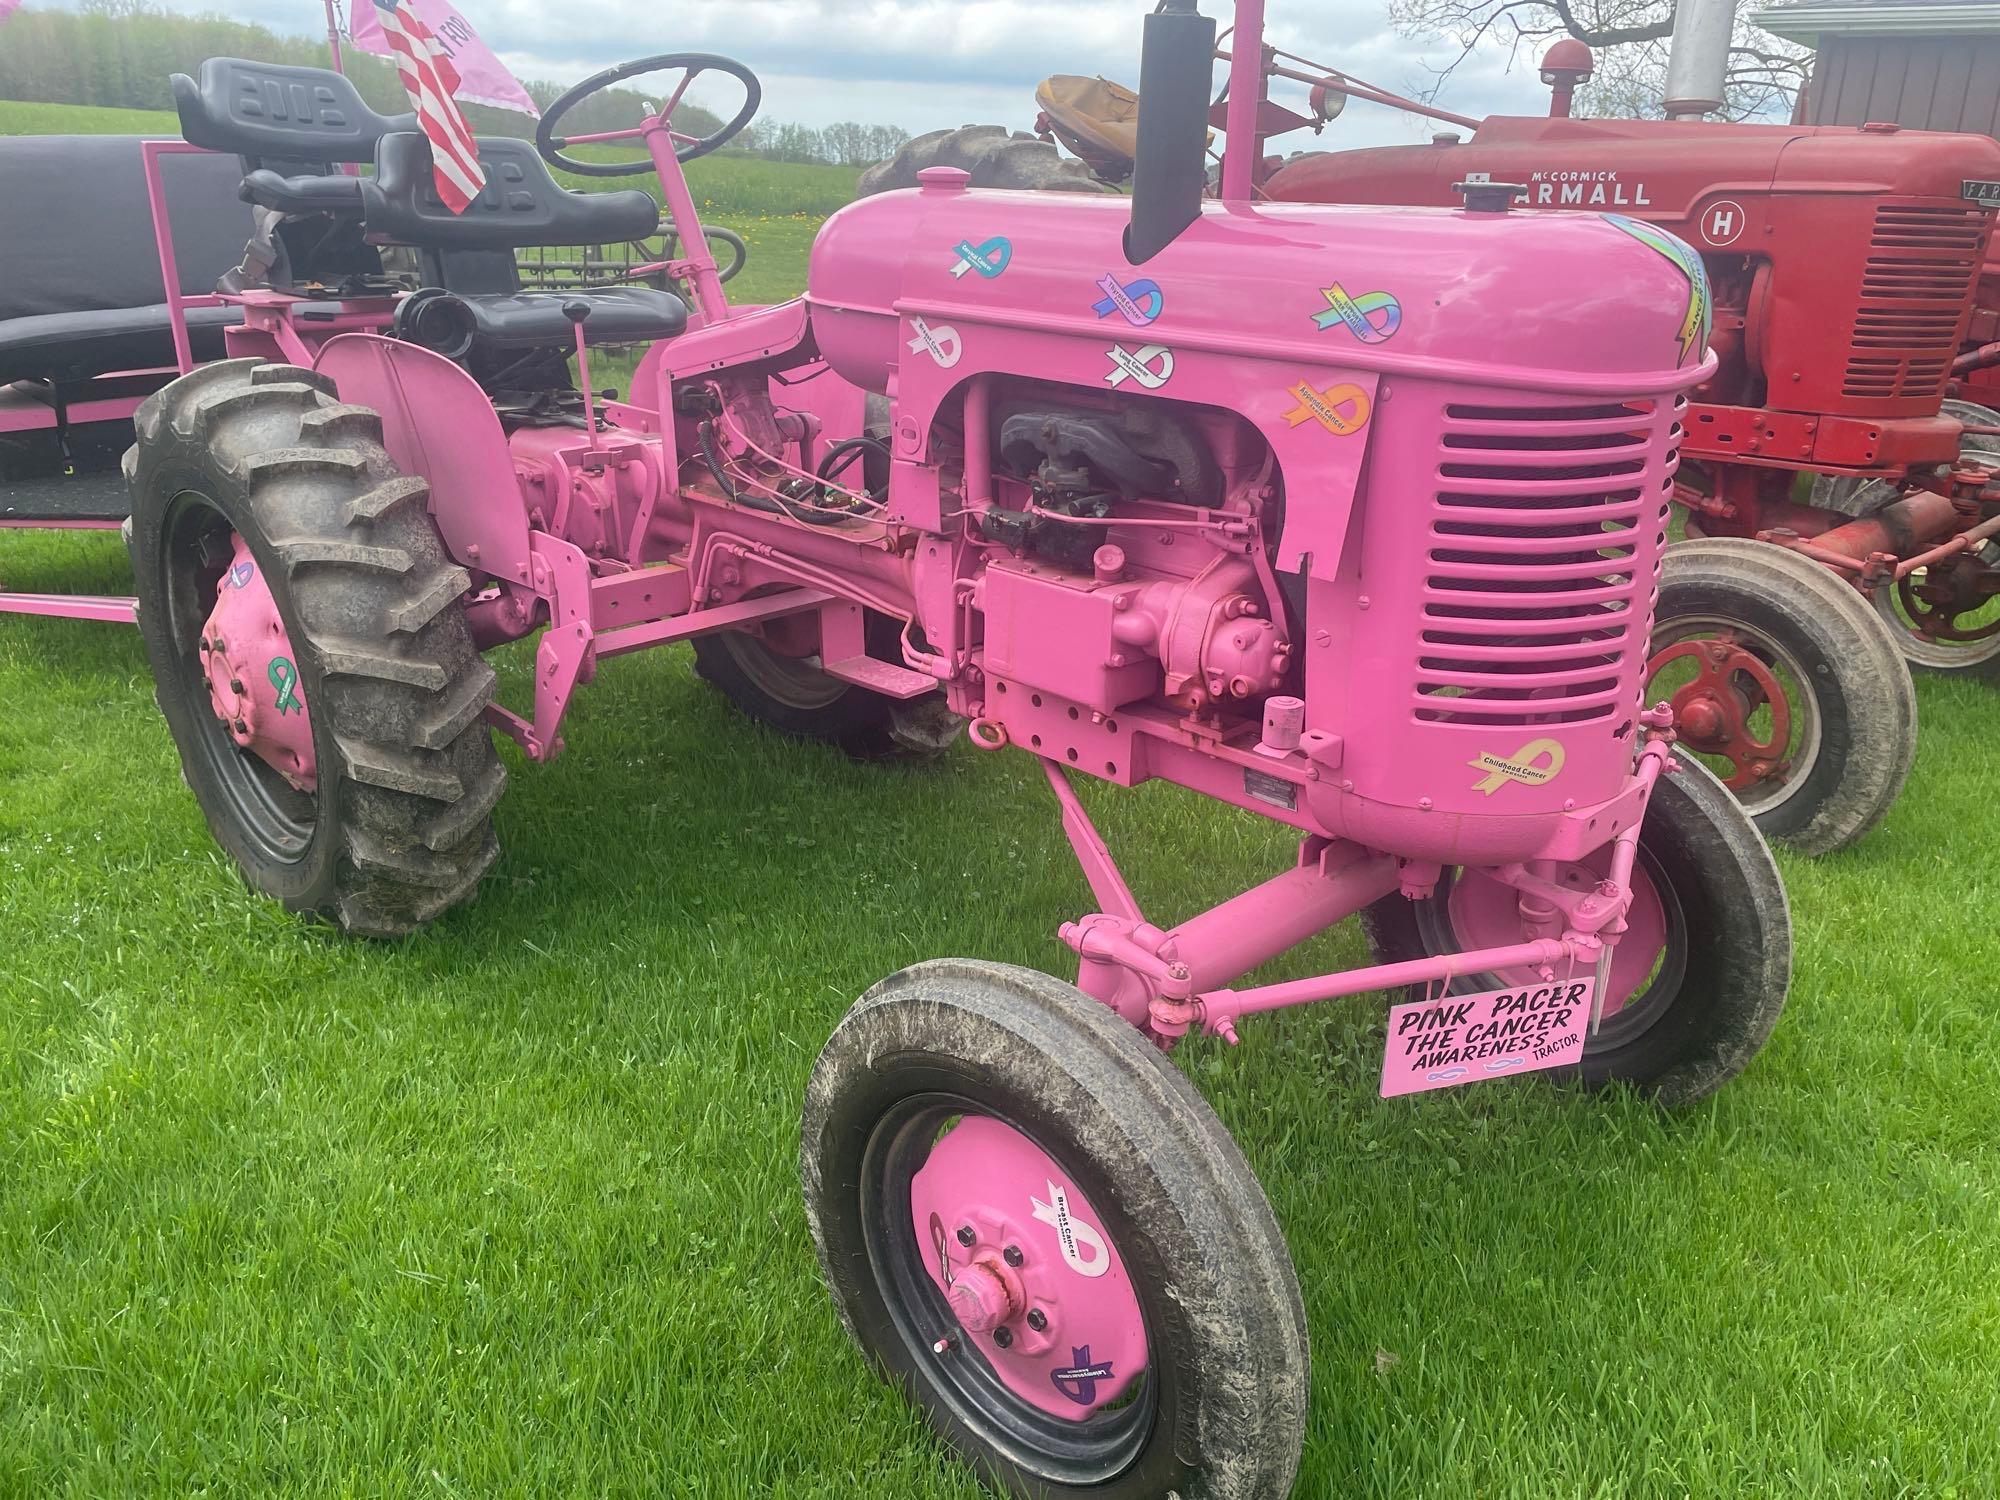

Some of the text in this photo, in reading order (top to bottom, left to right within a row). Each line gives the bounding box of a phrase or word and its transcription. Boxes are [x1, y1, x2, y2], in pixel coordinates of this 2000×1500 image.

[440, 16, 476, 47] FOR
[1531, 171, 1617, 182] McCORMICK
[1712, 211, 1733, 236] H
[1108, 282, 1141, 320] Thyroid Cancer
[1119, 351, 1149, 377] Lung Cancer
[1299, 386, 1345, 430] Appendix Cancer
[1483, 757, 1547, 780] Childhood Cancer
[1398, 983, 1587, 1036] PINK PACER
[1405, 1008, 1572, 1055] THE CANCER
[1532, 1033, 1580, 1061] TRACTOR
[1411, 1031, 1549, 1071] AWARENESS
[1057, 1196, 1077, 1258] Breast Cancer
